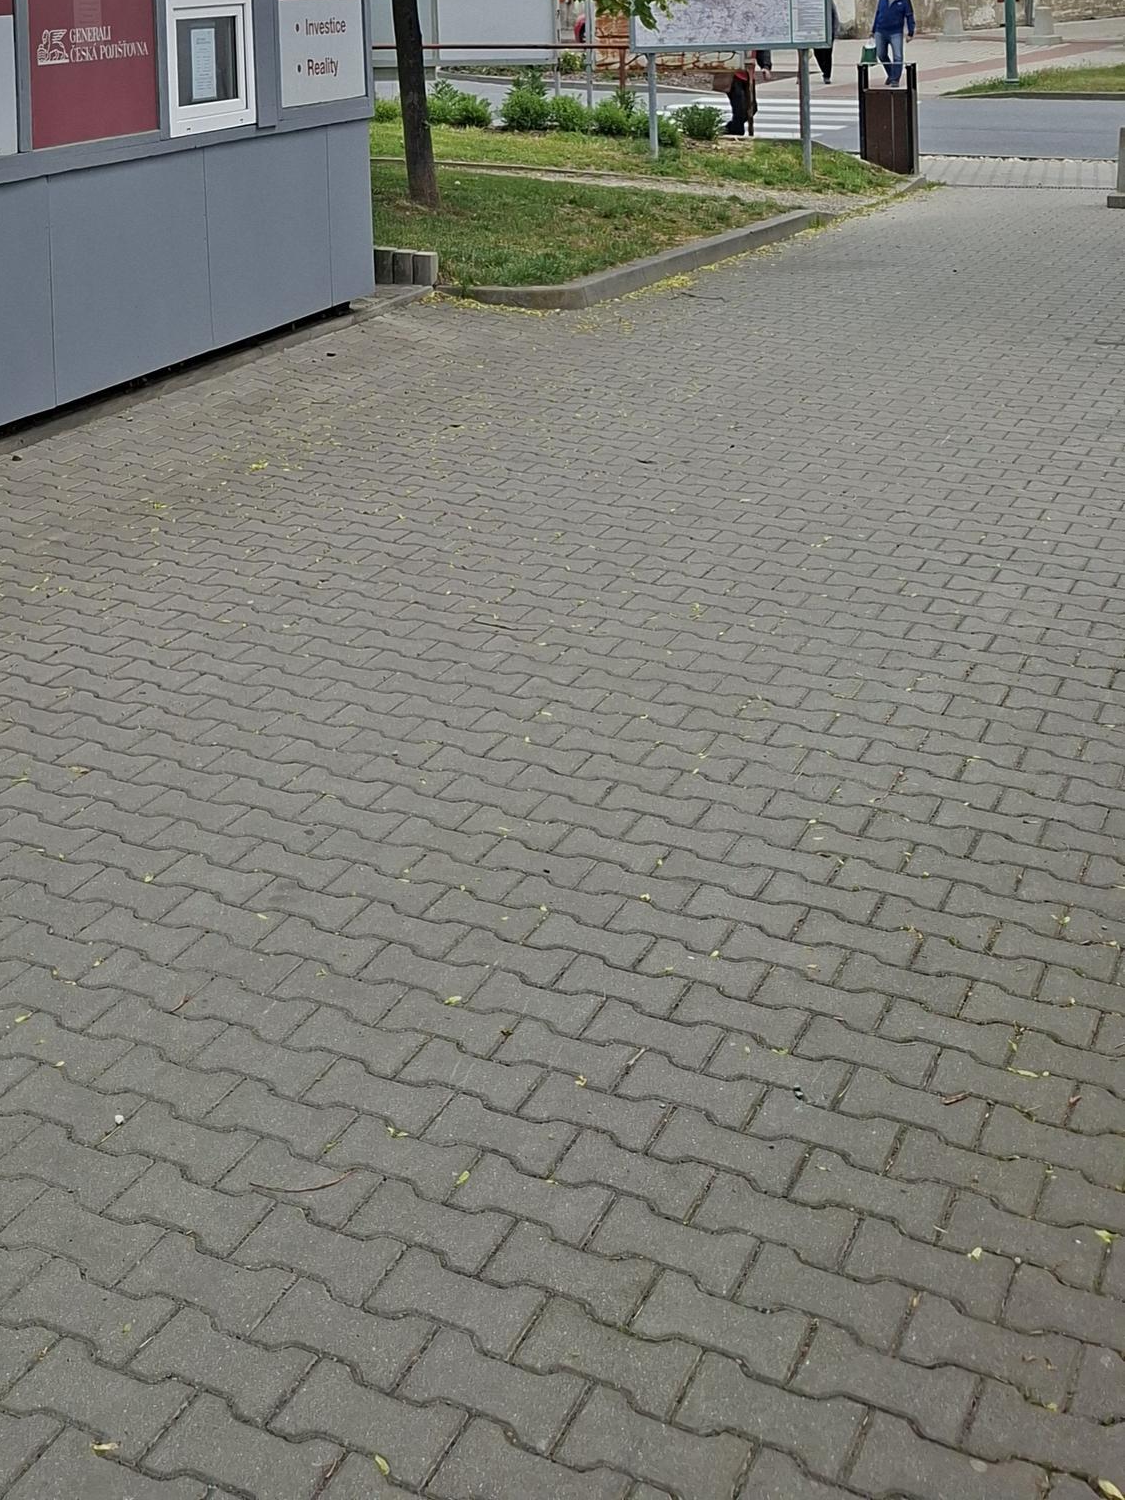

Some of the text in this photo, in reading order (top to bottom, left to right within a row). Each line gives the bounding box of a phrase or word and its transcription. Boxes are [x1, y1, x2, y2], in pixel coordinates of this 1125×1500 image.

[70, 25, 112, 43] GENERALI
[305, 17, 346, 36] Investice
[70, 40, 149, 62] ČESKÁ POJIŠŤOVNA
[307, 57, 339, 77] Reality
